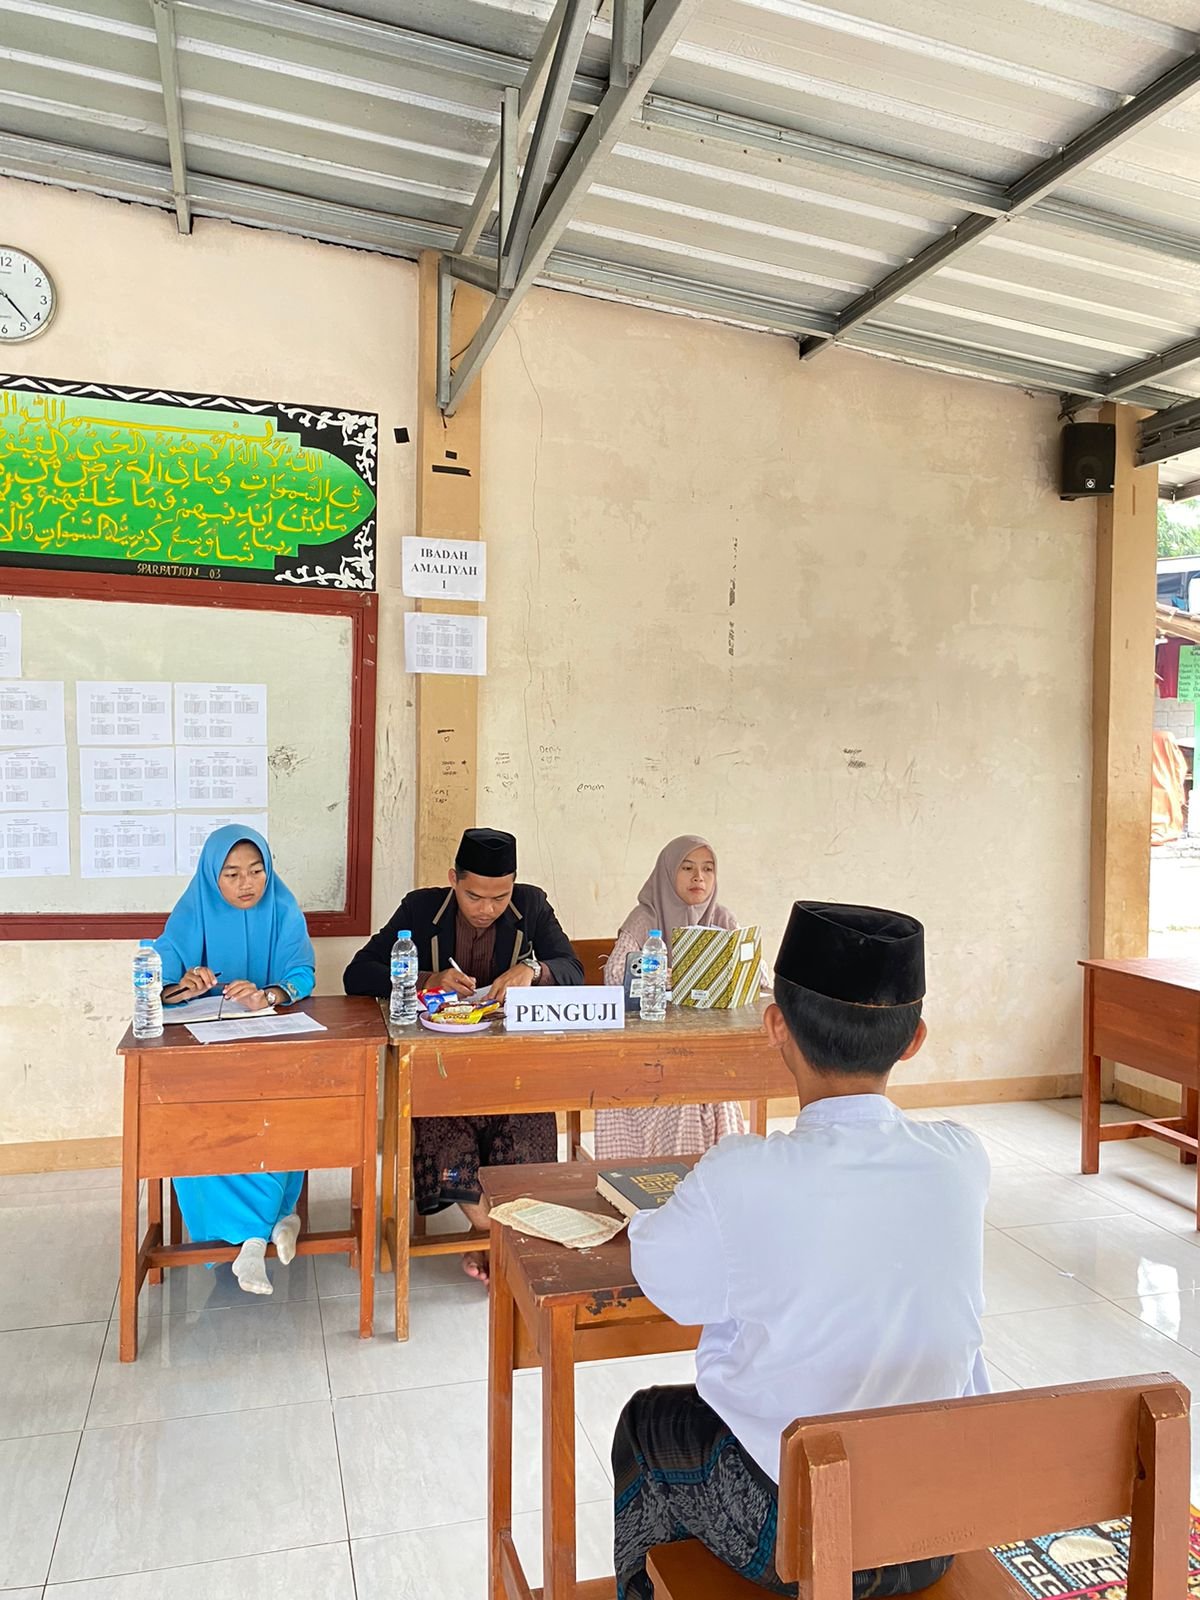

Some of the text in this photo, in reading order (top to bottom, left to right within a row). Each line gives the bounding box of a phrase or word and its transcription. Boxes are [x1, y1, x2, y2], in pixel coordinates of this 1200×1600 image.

[0, 256, 12, 267] 12
[23, 263, 27, 273] 1
[34, 277, 42, 287] 2
[40, 295, 48, 305] 3
[33, 312, 41, 321] 4
[1, 324, 8, 334] 6
[20, 322, 27, 331] 5
[421, 548, 468, 560] IBADAH
[411, 563, 478, 576] AMALIYAH
[515, 1003, 617, 1022] PENGUJI
